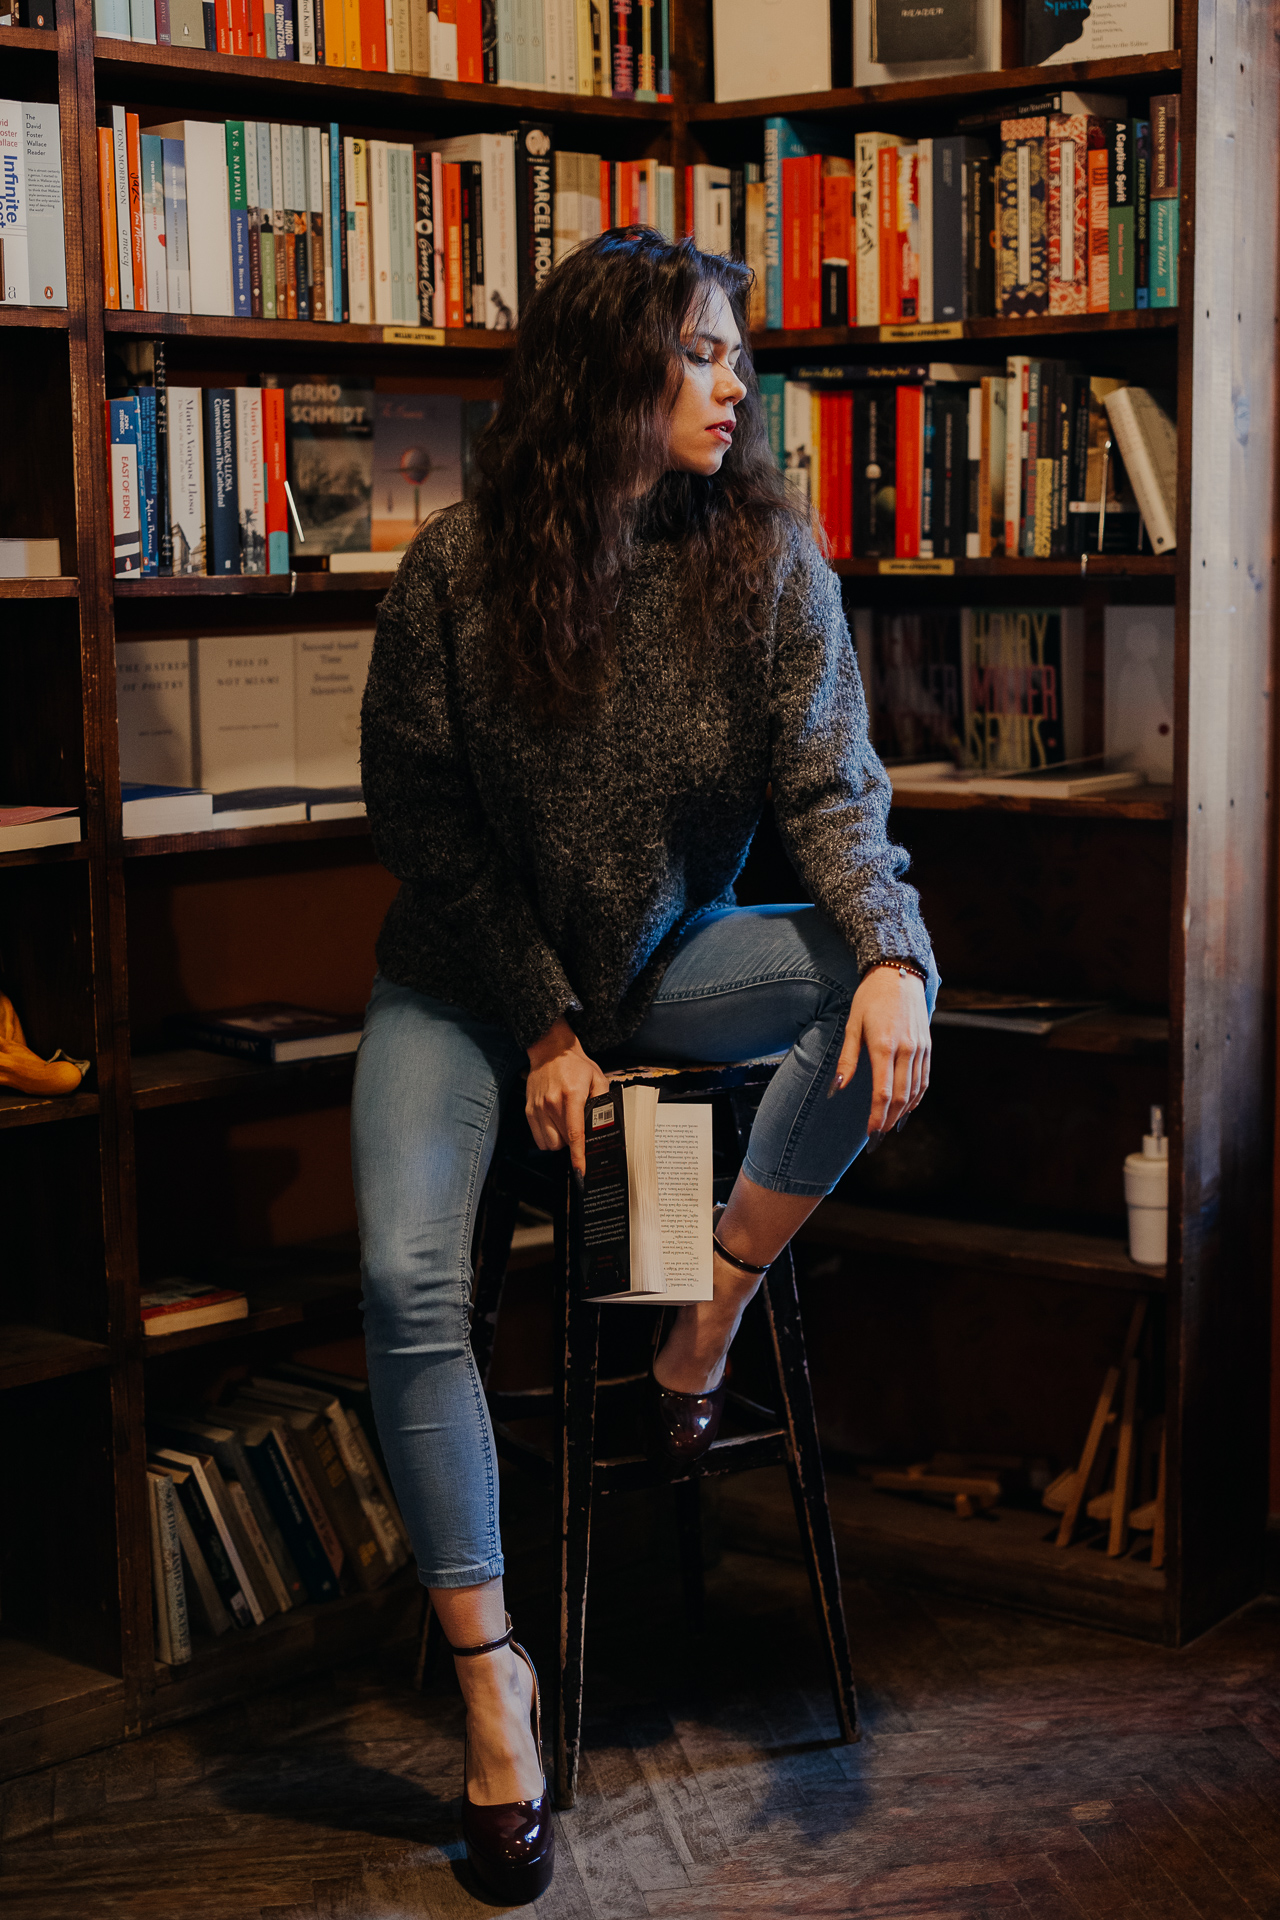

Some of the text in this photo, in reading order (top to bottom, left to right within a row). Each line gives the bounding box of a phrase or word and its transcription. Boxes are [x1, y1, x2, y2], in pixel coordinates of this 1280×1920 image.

[303, 16, 311, 37] Kubin
[1044, 0, 1089, 16] Speak
[275, 3, 287, 58] KAZANTZAKIS
[284, 20, 294, 46] NIKOS
[613, 44, 634, 93] PLEXUS
[26, 140, 48, 148] Wallace
[1114, 123, 1127, 202] A Captive Spirit
[1158, 106, 1166, 188] PUSHKIN'S BUTTON
[4, 155, 20, 224] Infinite
[233, 156, 242, 202] NAIPAUL
[1138, 158, 1146, 239] FATHERS AND SONS
[534, 166, 552, 290] MARCEL PROU
[416, 173, 434, 322] 1984 George Orwell
[290, 384, 342, 402] ARNO
[214, 398, 222, 447] Conversation
[291, 406, 366, 424] SCHMIDT
[185, 399, 197, 515] Mario Vargas Llosa
[222, 398, 233, 492] MARIO VARGAS LLOSA
[250, 400, 262, 514] Mario Vargas Llosa
[122, 480, 130, 492] OF
[216, 471, 225, 508] Cathedral
[145, 498, 154, 522] Dylan
[118, 661, 138, 673] THE
[227, 658, 254, 668] THIS
[320, 654, 342, 664] Time
[122, 680, 184, 693] OF POETRY
[216, 676, 280, 688] NOT MIAMI
